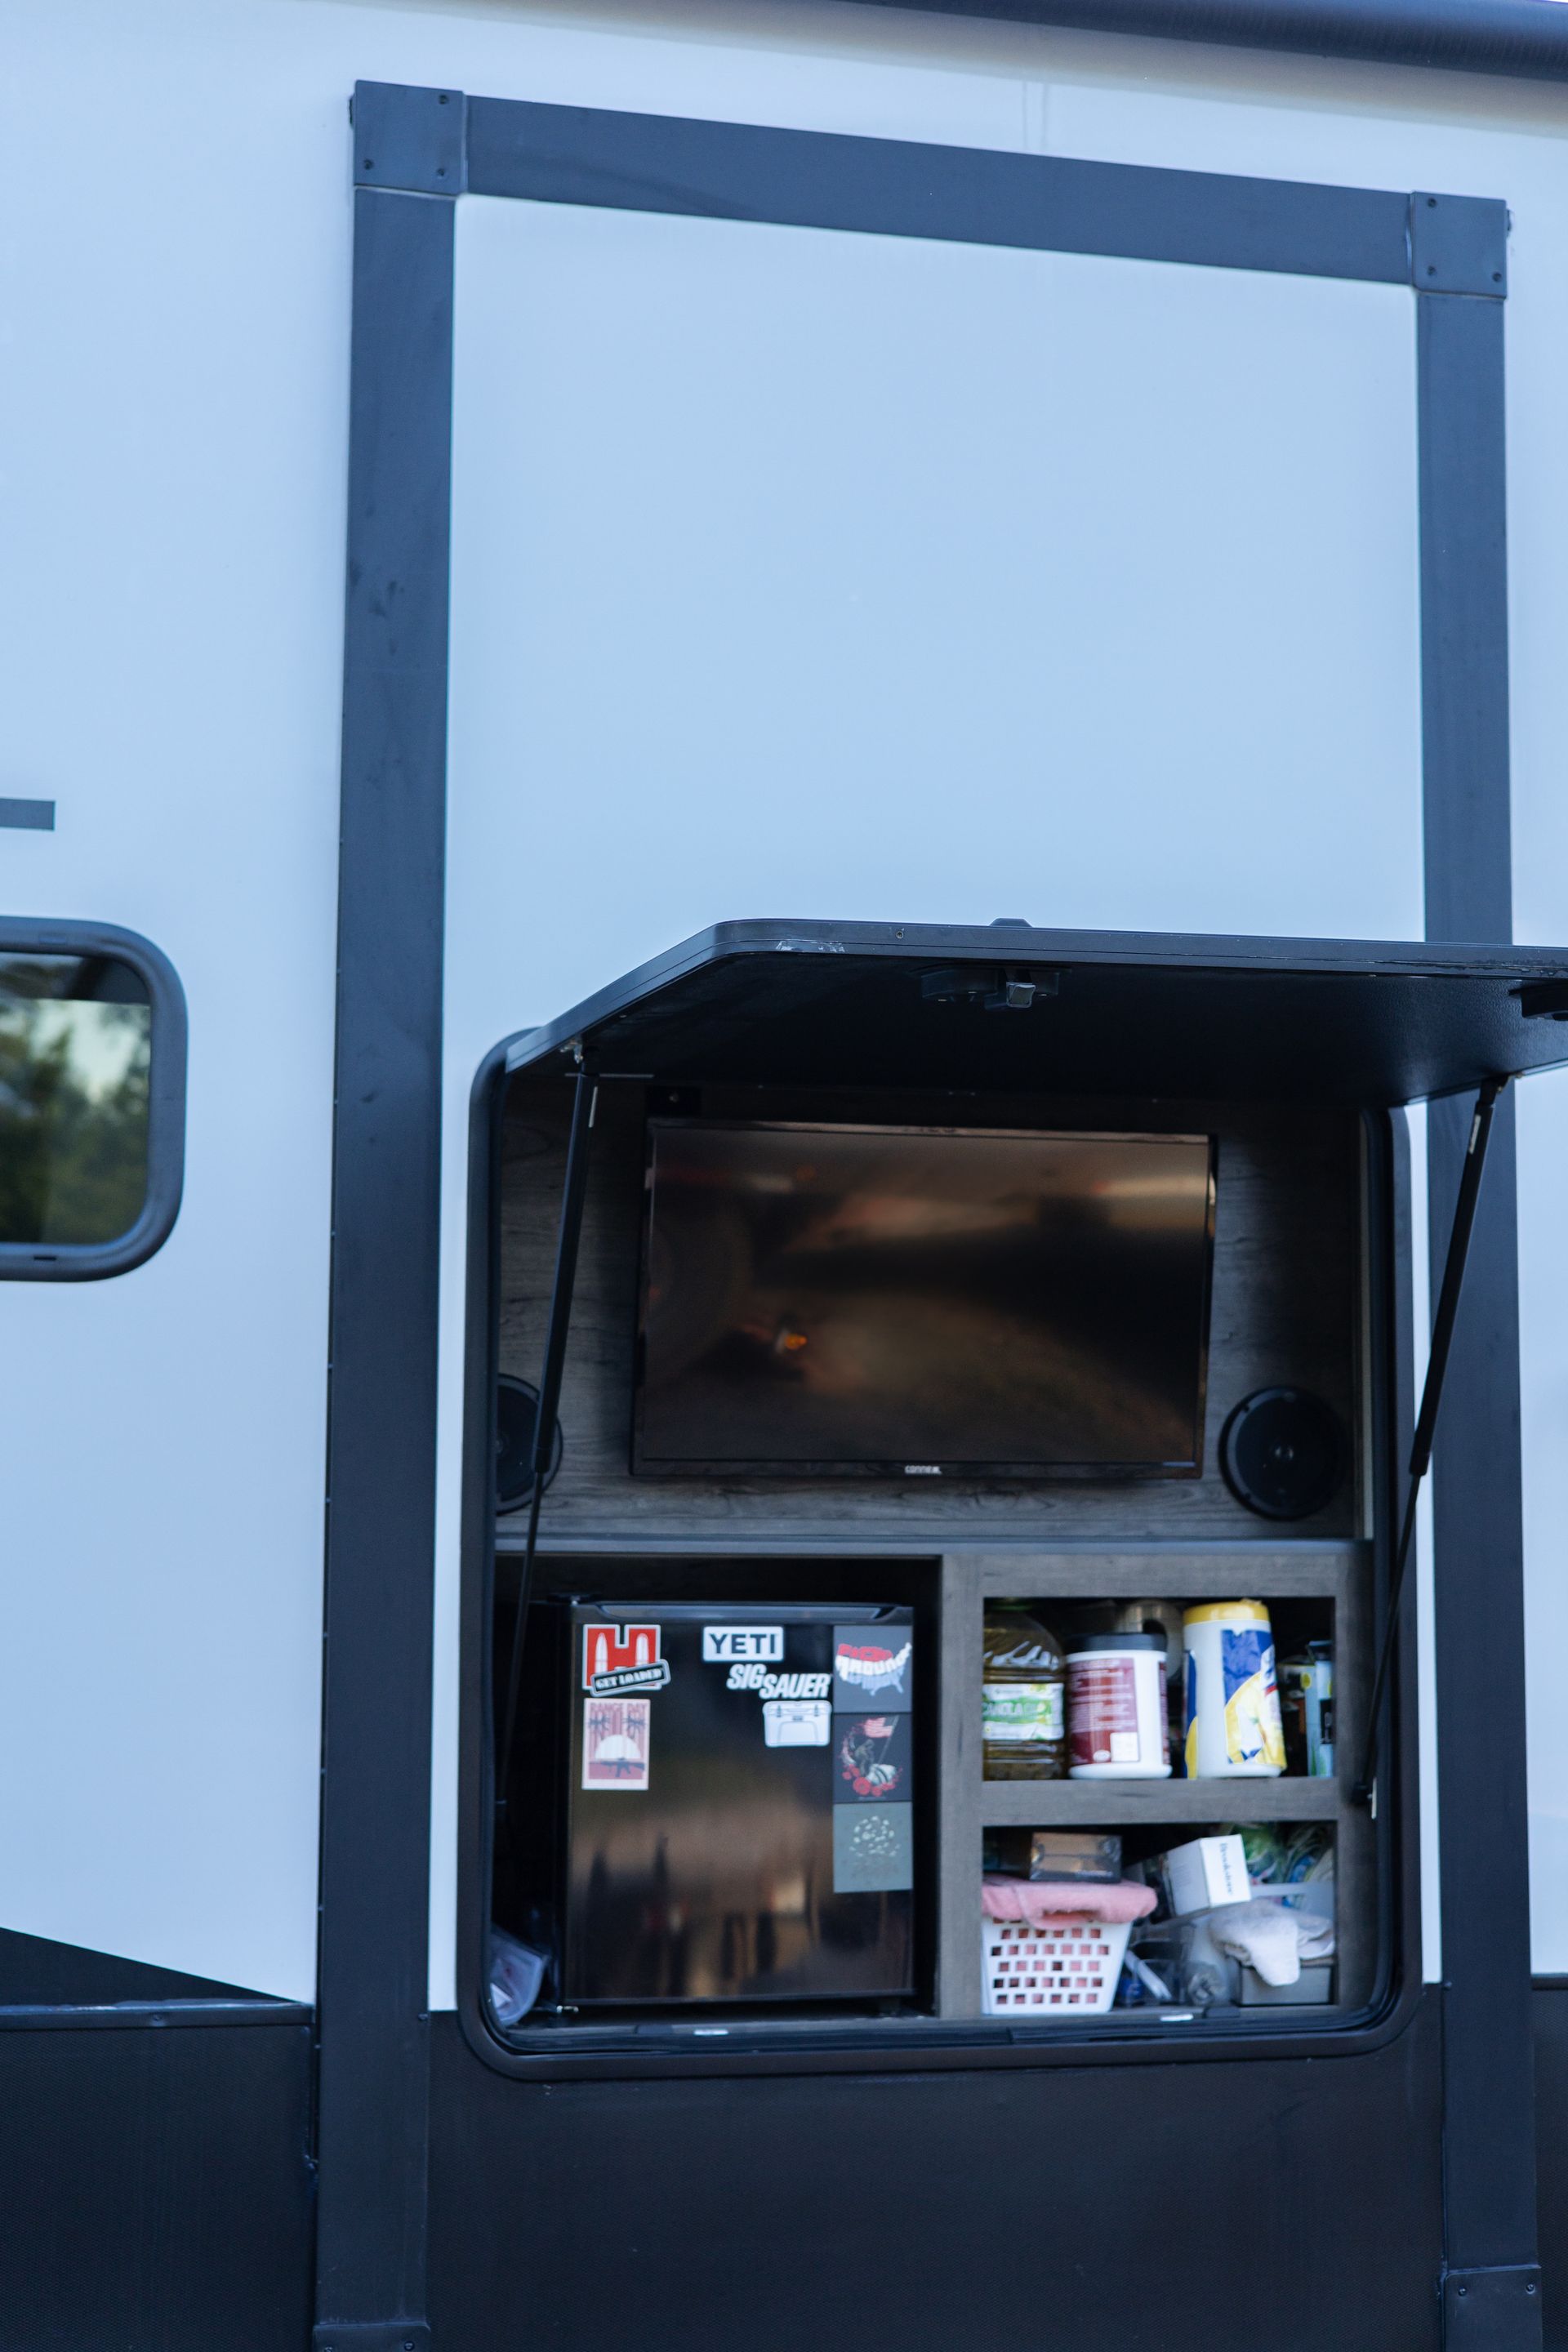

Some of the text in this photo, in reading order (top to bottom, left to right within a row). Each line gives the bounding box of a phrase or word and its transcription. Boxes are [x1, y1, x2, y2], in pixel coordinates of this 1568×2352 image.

[710, 1633, 776, 1655] YETI
[726, 1664, 768, 1690] SIG
[759, 1673, 831, 1699] SAUER
[626, 1702, 646, 1714] DAY
